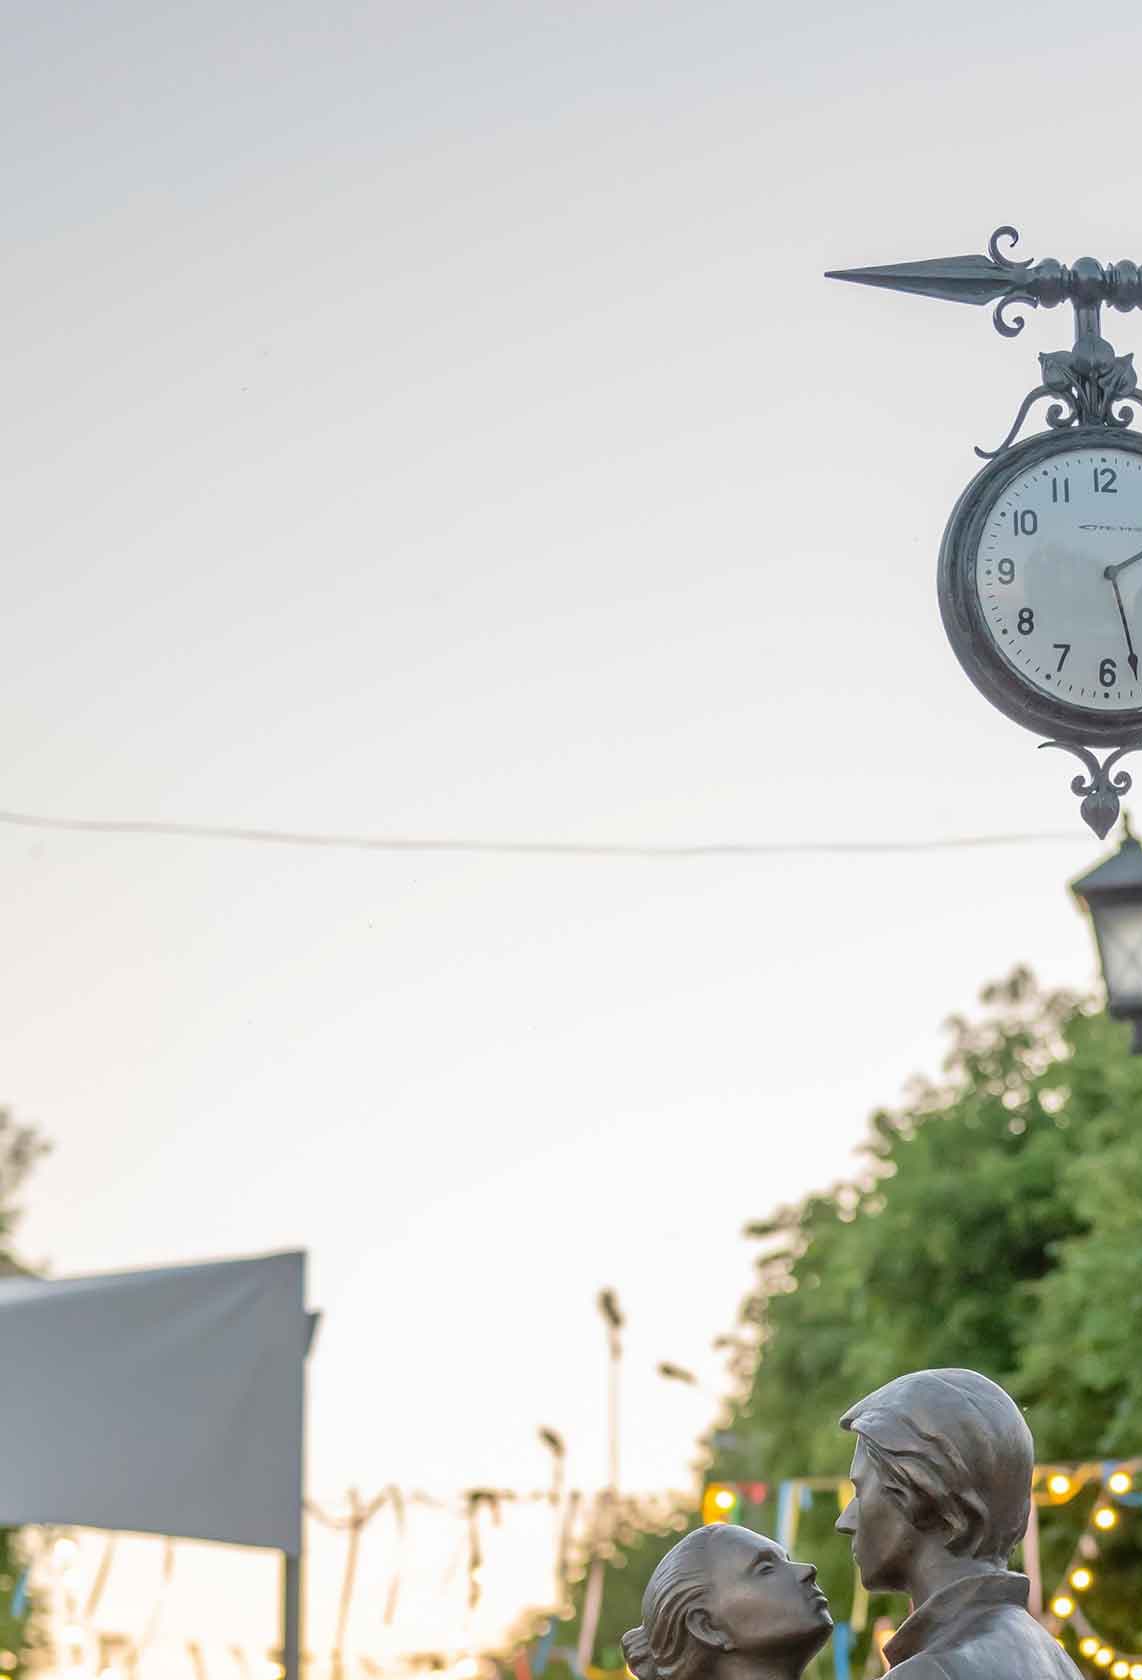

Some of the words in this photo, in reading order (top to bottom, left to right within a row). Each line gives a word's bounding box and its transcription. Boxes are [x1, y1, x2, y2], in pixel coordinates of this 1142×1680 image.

[1052, 477, 1069, 502] 11
[1093, 468, 1117, 492] 12
[1013, 509, 1038, 536] 10
[998, 558, 1015, 584] 9
[1017, 608, 1034, 635] 8
[1053, 644, 1070, 672] 7
[1100, 658, 1117, 687] 6
